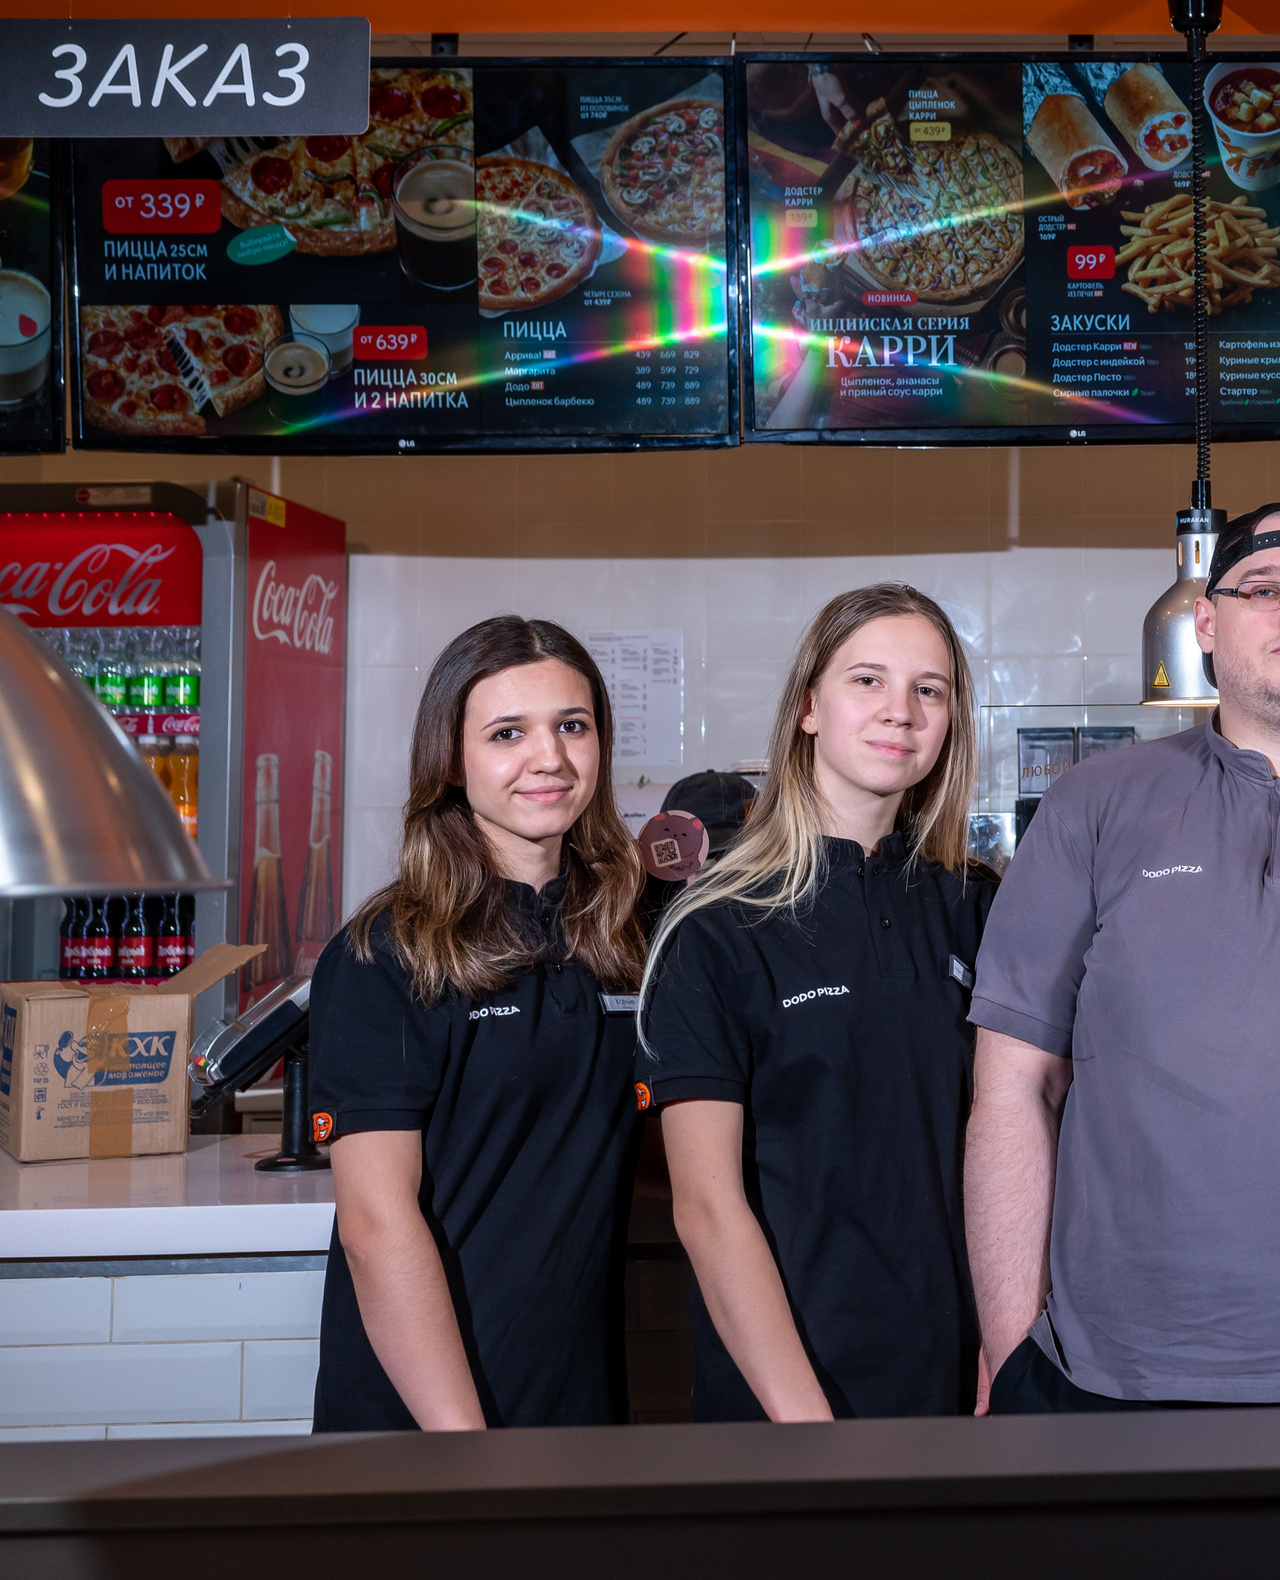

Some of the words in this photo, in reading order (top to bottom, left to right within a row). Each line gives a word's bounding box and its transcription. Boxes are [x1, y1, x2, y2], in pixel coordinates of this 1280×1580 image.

[38, 43, 310, 109] ЗАКАЗ
[908, 90, 939, 99] ПИЦЦА
[908, 100, 956, 110] ЦЫПЛЕНОК
[909, 111, 936, 120] КАРРИ
[784, 187, 823, 197] ДОДСТЕР
[115, 197, 134, 208] от
[785, 198, 813, 206] КАРРИ
[1038, 214, 1065, 222] ОСТРЫЙ
[104, 240, 167, 260] ПИЦЦА
[170, 244, 208, 257] 25СМ
[104, 263, 117, 280] И
[121, 263, 207, 280] НАПИТОК
[868, 294, 912, 303] НОВИНКА
[810, 316, 913, 333] ИНДИЙСКАЯ
[917, 317, 970, 330] СЕРИЯ
[1051, 314, 1130, 331] ЗАКУСКИ
[504, 321, 567, 341] ПИЦЦА
[360, 336, 373, 344] от
[1219, 340, 1269, 351] Картофель
[826, 335, 957, 367] КАРРИ
[1052, 343, 1093, 353] Додстер
[1094, 343, 1122, 352] Карри
[504, 351, 542, 361] Аррива!
[635, 351, 651, 359] 439
[660, 351, 676, 359] 669
[684, 351, 700, 359] 829
[1220, 356, 1259, 367] Куриные
[1053, 358, 1093, 368] Додстер
[1100, 357, 1146, 368] индейкой
[504, 367, 556, 377] Маргарита
[635, 366, 651, 375] 389
[660, 366, 676, 375] 599
[684, 366, 699, 375] 729
[1220, 372, 1259, 381] Куриные
[354, 368, 417, 389] ПИЦЦА
[420, 372, 458, 386] 30СМ
[841, 377, 894, 387] Цыпленок,
[896, 378, 940, 386] ананасы
[1053, 373, 1093, 383] Додстер
[1094, 374, 1122, 382] Песто
[505, 382, 530, 392] Додо
[636, 381, 651, 390] 489
[661, 381, 676, 390] 739
[684, 381, 700, 390] 889
[1220, 387, 1258, 396] Стартер
[848, 387, 886, 398] пряный
[888, 388, 911, 396] соус
[913, 388, 943, 398] карри
[1053, 389, 1091, 398] Сырные
[1091, 389, 1130, 397] палочки
[354, 392, 367, 409] И
[371, 392, 381, 409] 2
[385, 392, 469, 409] НАПИТКА
[505, 397, 553, 407] Цыпленок
[554, 396, 594, 407] барбекю
[636, 397, 651, 405] 489
[661, 397, 676, 405] 739
[684, 397, 700, 405] 889
[253, 560, 338, 655] Coca-Cola
[1021, 758, 1071, 779] ЛЮБОЙ
[1142, 868, 1170, 879] DODO
[1171, 865, 1203, 874] PIZZA
[782, 990, 816, 1008] DODO
[816, 985, 850, 998] PIZZA
[109, 1035, 171, 1058] КХК
[108, 1070, 165, 1080] мороженое
